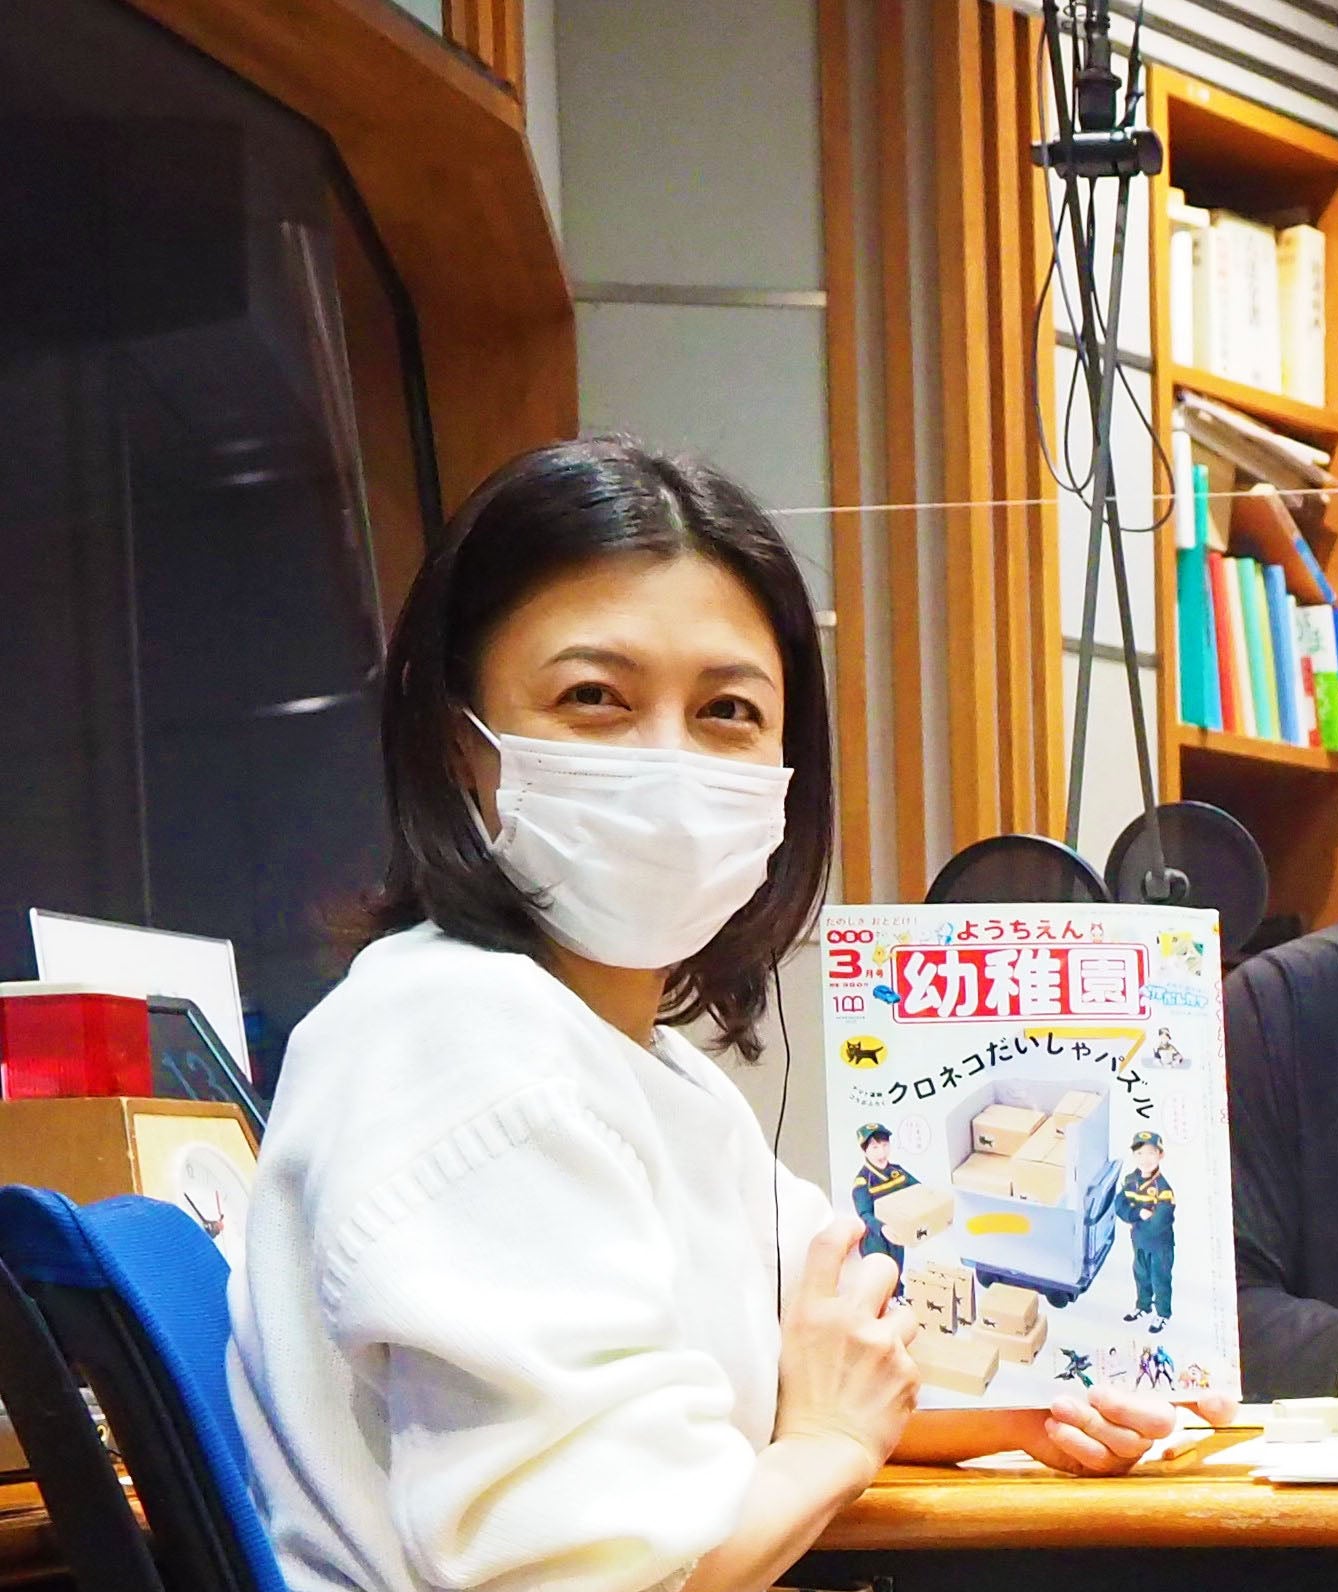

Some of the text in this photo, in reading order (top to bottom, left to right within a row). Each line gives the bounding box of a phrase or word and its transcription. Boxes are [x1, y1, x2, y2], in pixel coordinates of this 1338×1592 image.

[956, 919, 1084, 941] ようちえん
[828, 948, 884, 979] 3月号
[903, 947, 1141, 1018] 幼稚園
[888, 1031, 1155, 1119] クロネコだいしゃパズル
